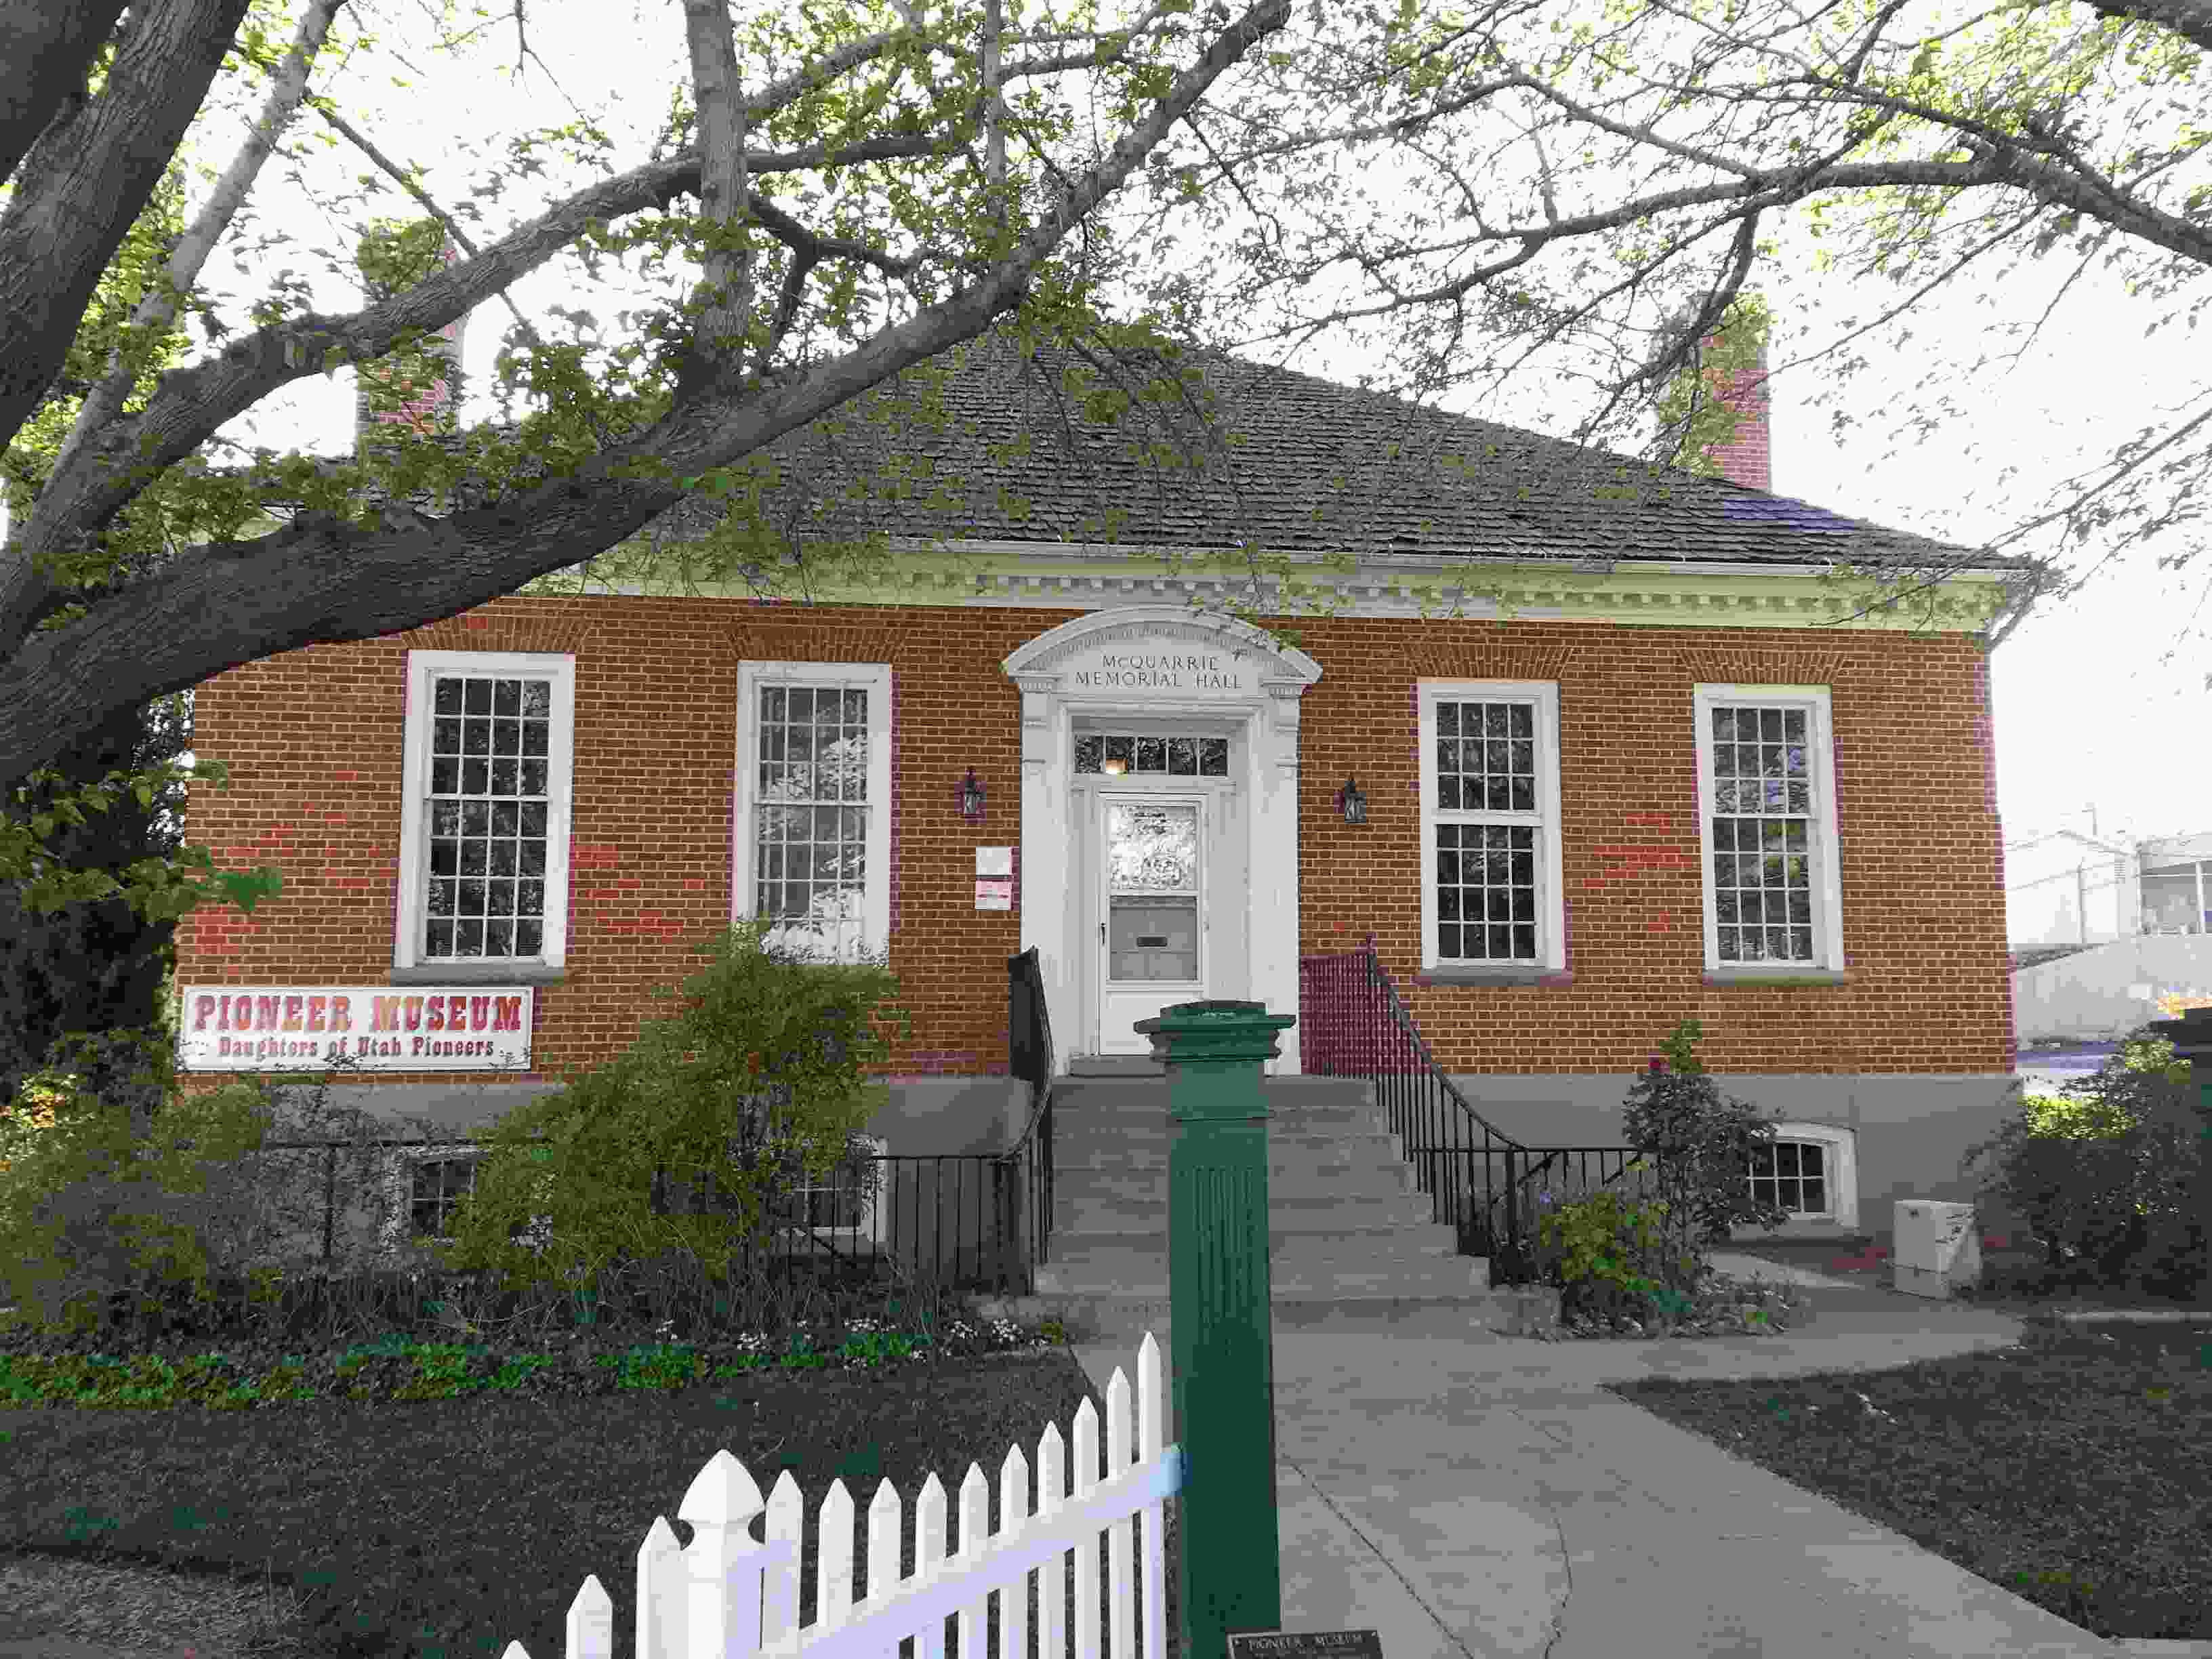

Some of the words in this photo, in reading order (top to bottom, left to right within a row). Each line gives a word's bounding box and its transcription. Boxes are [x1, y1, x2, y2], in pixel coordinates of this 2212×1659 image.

[1076, 672, 1183, 688] MEMORIAL
[1196, 673, 1242, 689] HALL
[195, 996, 351, 1031] PIONEER
[373, 996, 521, 1031] MUSEUM
[218, 1036, 318, 1060] Daughters
[328, 1037, 348, 1059] of
[358, 1037, 401, 1056] Utah
[412, 1037, 494, 1056] Pioneers
